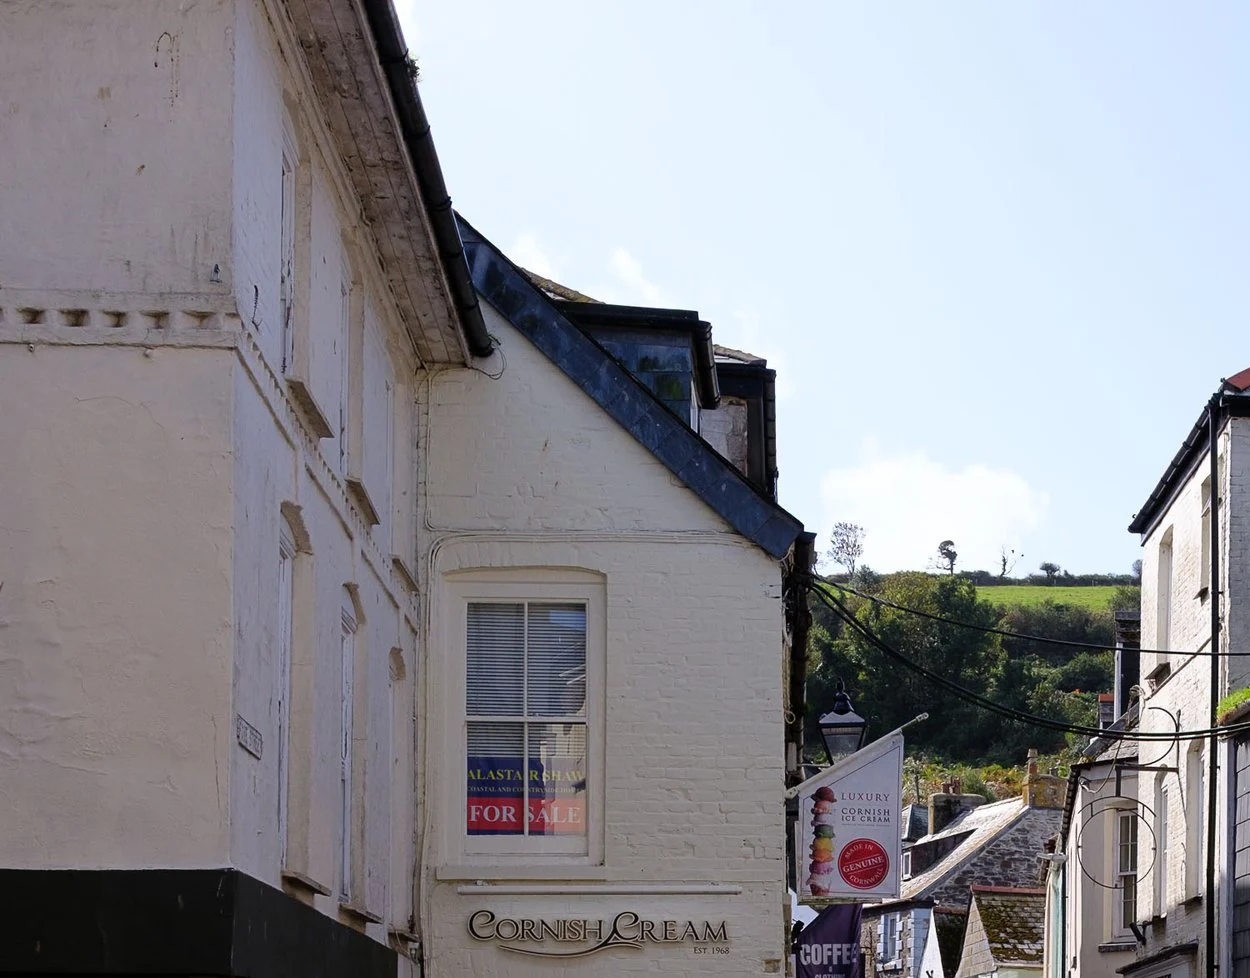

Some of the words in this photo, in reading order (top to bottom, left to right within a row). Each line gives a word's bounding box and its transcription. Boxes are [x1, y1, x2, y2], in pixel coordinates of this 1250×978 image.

[467, 768, 539, 781] ALASTAR
[841, 792, 890, 802] LUXURY
[470, 805, 517, 822] FOR
[527, 806, 581, 823] SALE
[841, 807, 890, 816] CORNISH
[860, 815, 890, 823] CREAM
[842, 856, 885, 873] GENUINE
[469, 909, 605, 942] CORNISH
[606, 910, 729, 943] CREAM
[712, 947, 729, 955] 1968
